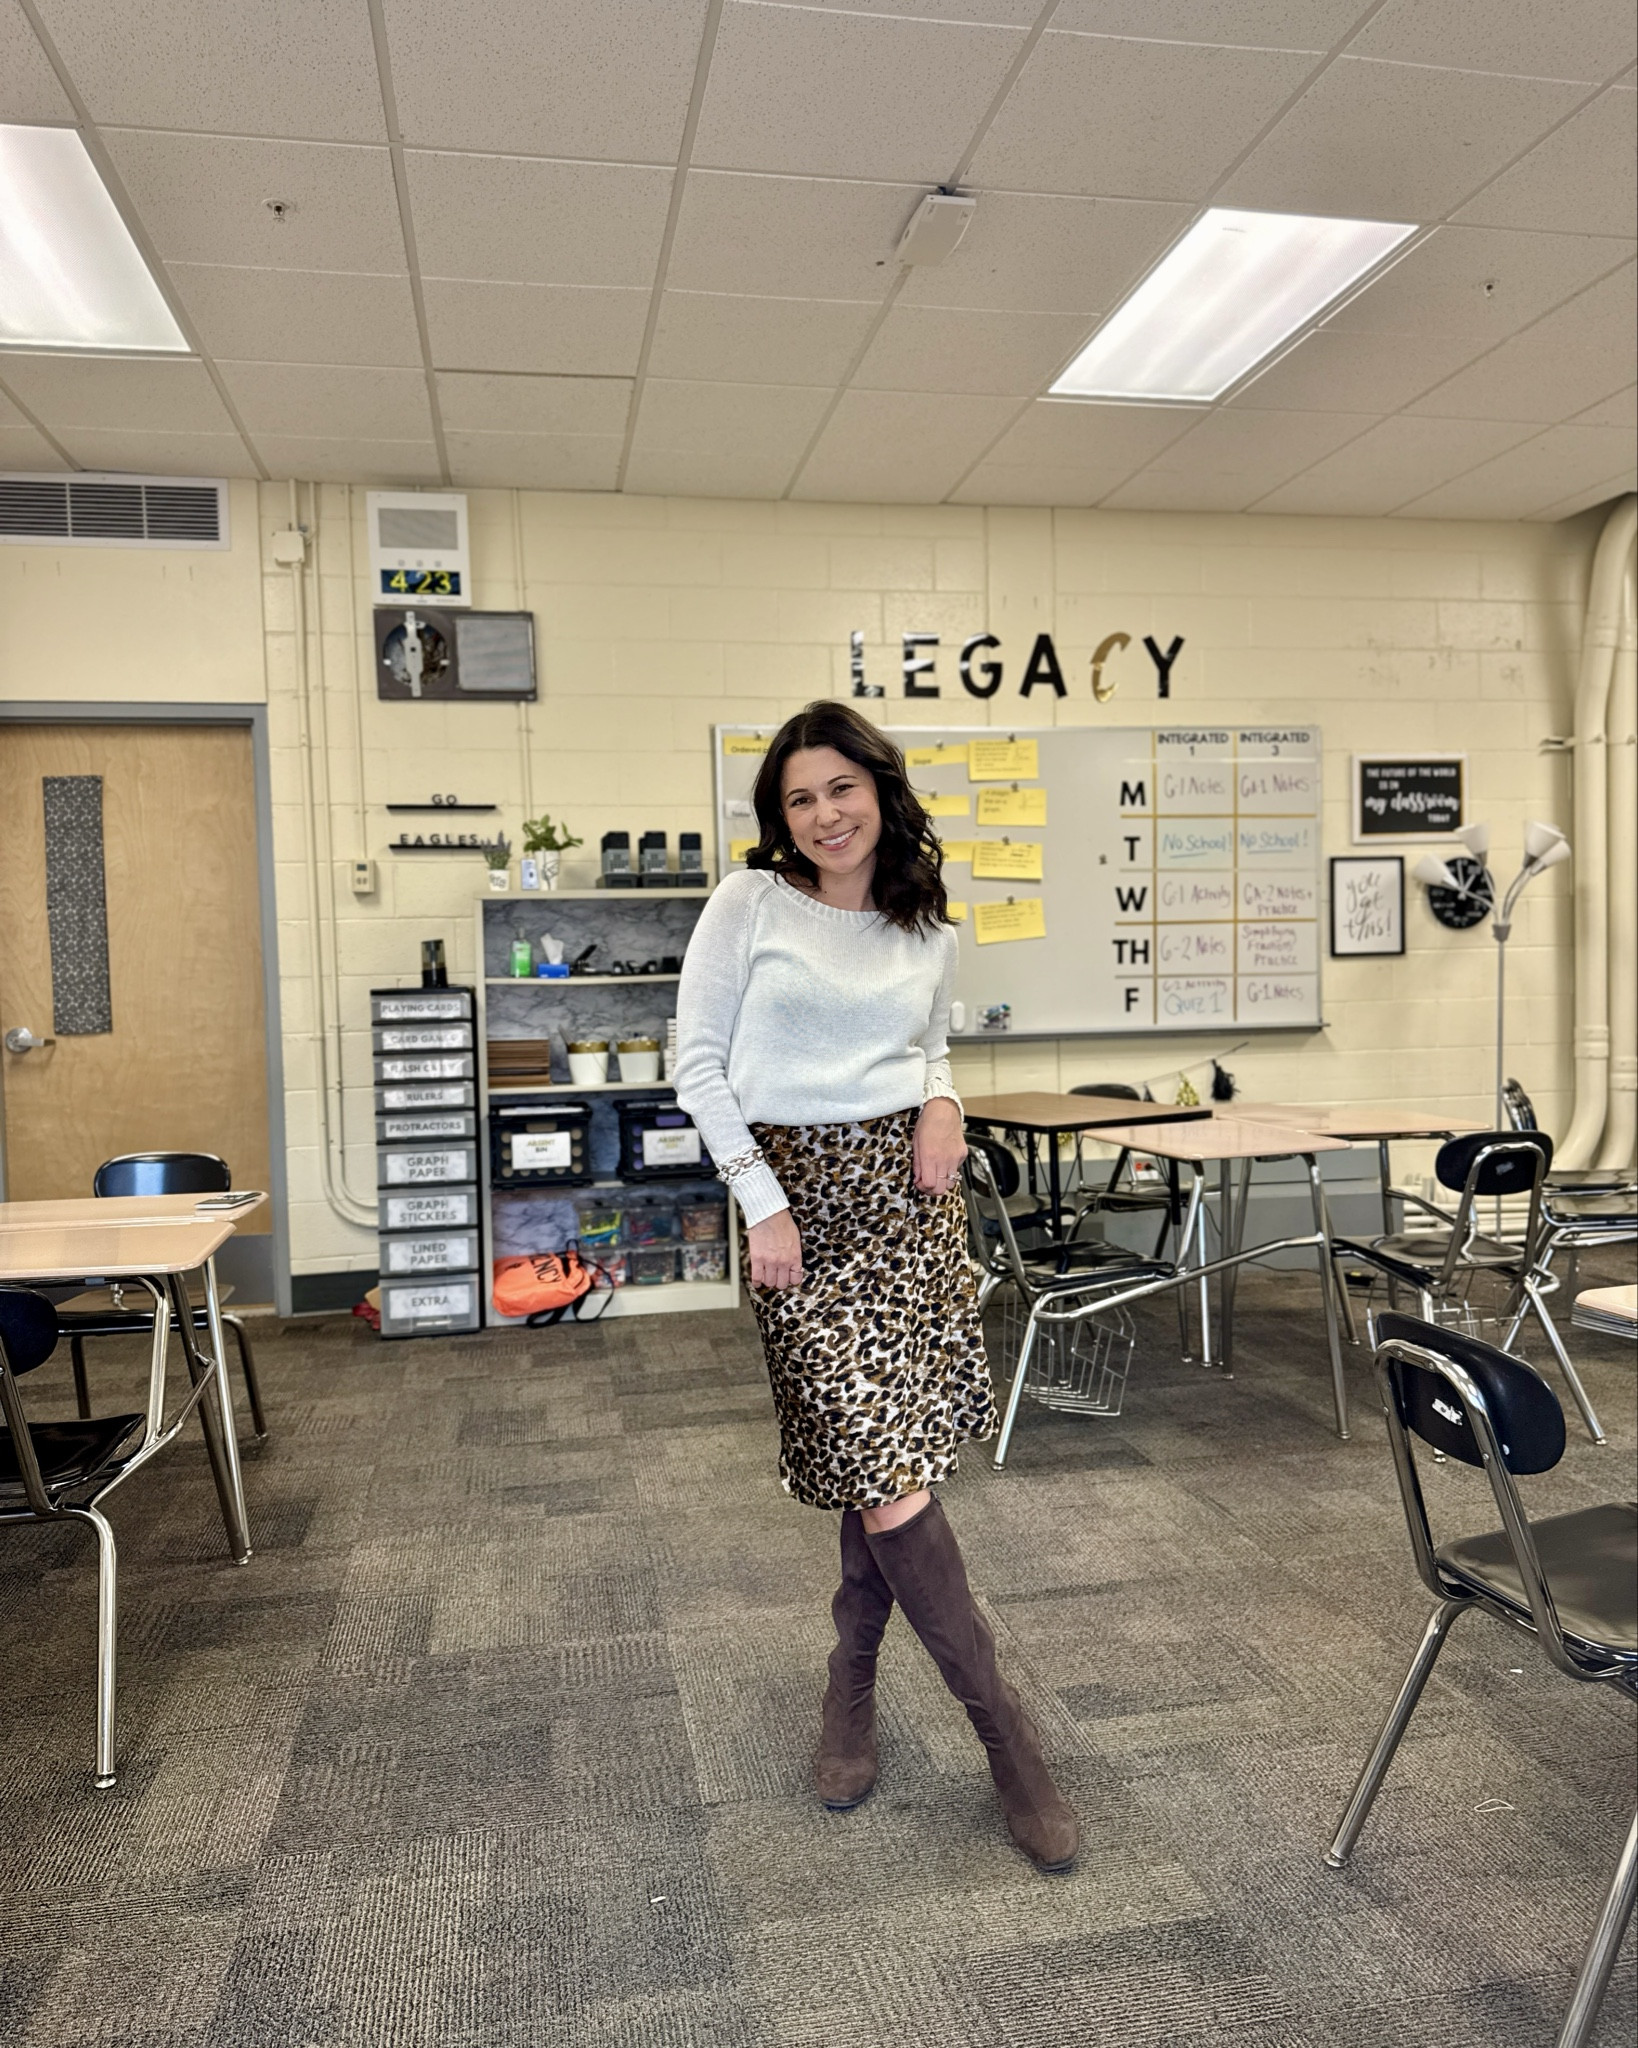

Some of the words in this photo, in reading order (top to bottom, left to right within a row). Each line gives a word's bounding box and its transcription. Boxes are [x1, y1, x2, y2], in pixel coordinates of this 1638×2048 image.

[851, 631, 1185, 703] LEGACY
[1158, 733, 1229, 744] INTEGRATED
[1239, 732, 1310, 743] INTEGRATED
[1189, 745, 1195, 756] 1
[1271, 745, 1280, 756] 3
[1190, 776, 1226, 795] Notes
[1273, 774, 1310, 793] Notes
[431, 793, 458, 805] GO
[1119, 780, 1146, 806] M
[1364, 796, 1388, 816] my
[400, 833, 478, 845] EAGLES
[1163, 833, 1183, 852] No
[1240, 832, 1258, 848] No
[1123, 836, 1141, 861] T
[1345, 871, 1382, 914] you
[1115, 886, 1148, 912] W
[1354, 891, 1384, 926] got
[1195, 935, 1227, 956] Notes
[1112, 939, 1149, 965] TH
[1125, 987, 1140, 1013] F
[382, 1004, 425, 1013] PLAYING
[427, 1003, 460, 1012] CARDS
[406, 1092, 443, 1102] RULERS
[389, 1121, 462, 1132] PROTRACTORS
[407, 1156, 449, 1167] GRAPH
[409, 1167, 446, 1178] PAPER
[406, 1200, 449, 1211] GRAPH
[399, 1211, 457, 1223] STICKERS
[412, 1243, 447, 1254] LINED
[410, 1254, 448, 1265] PAPER
[411, 1295, 451, 1307] EXTRA
